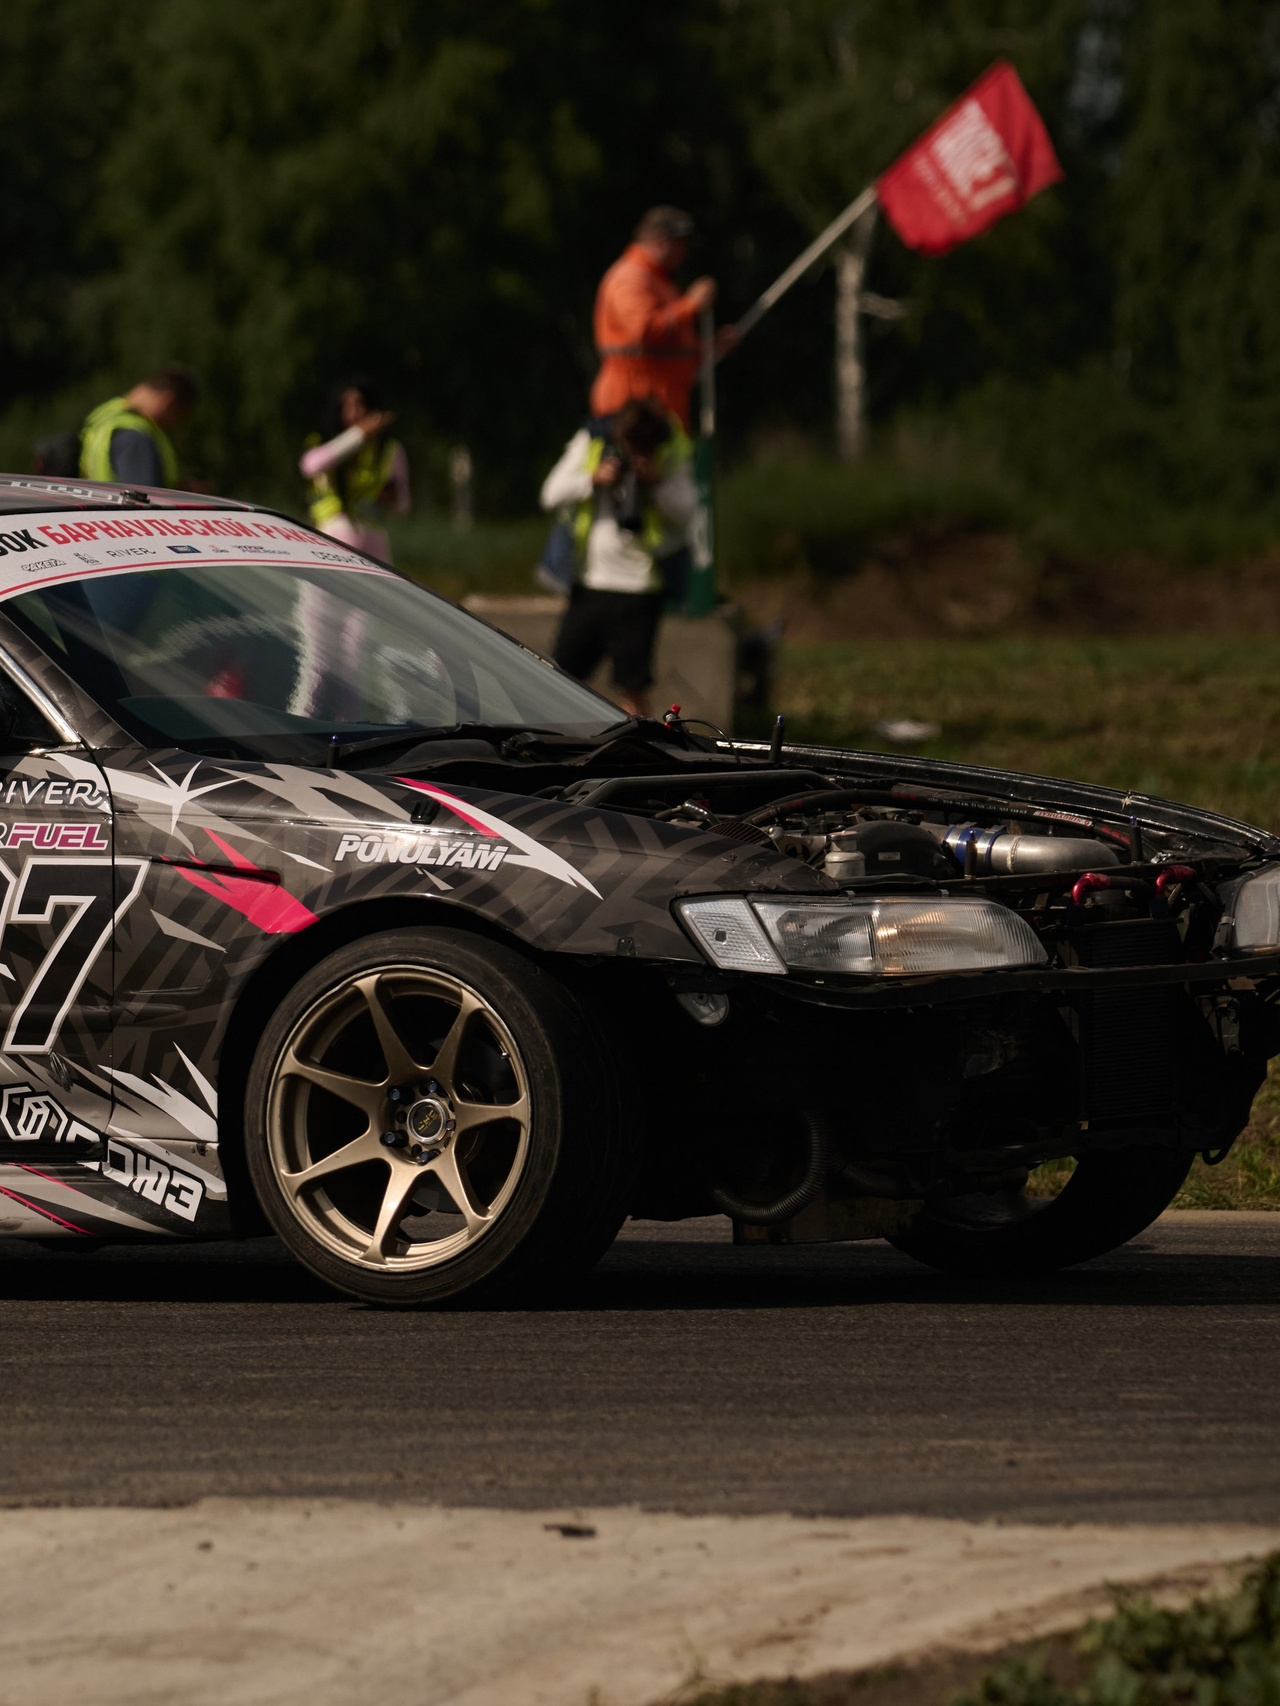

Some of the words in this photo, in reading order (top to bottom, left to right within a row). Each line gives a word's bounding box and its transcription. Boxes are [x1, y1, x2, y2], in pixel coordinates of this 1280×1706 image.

[37, 516, 261, 545] БАРНАУЛЬСКОЙ
[106, 547, 156, 559] RIVER
[333, 833, 509, 872] PONULYAM
